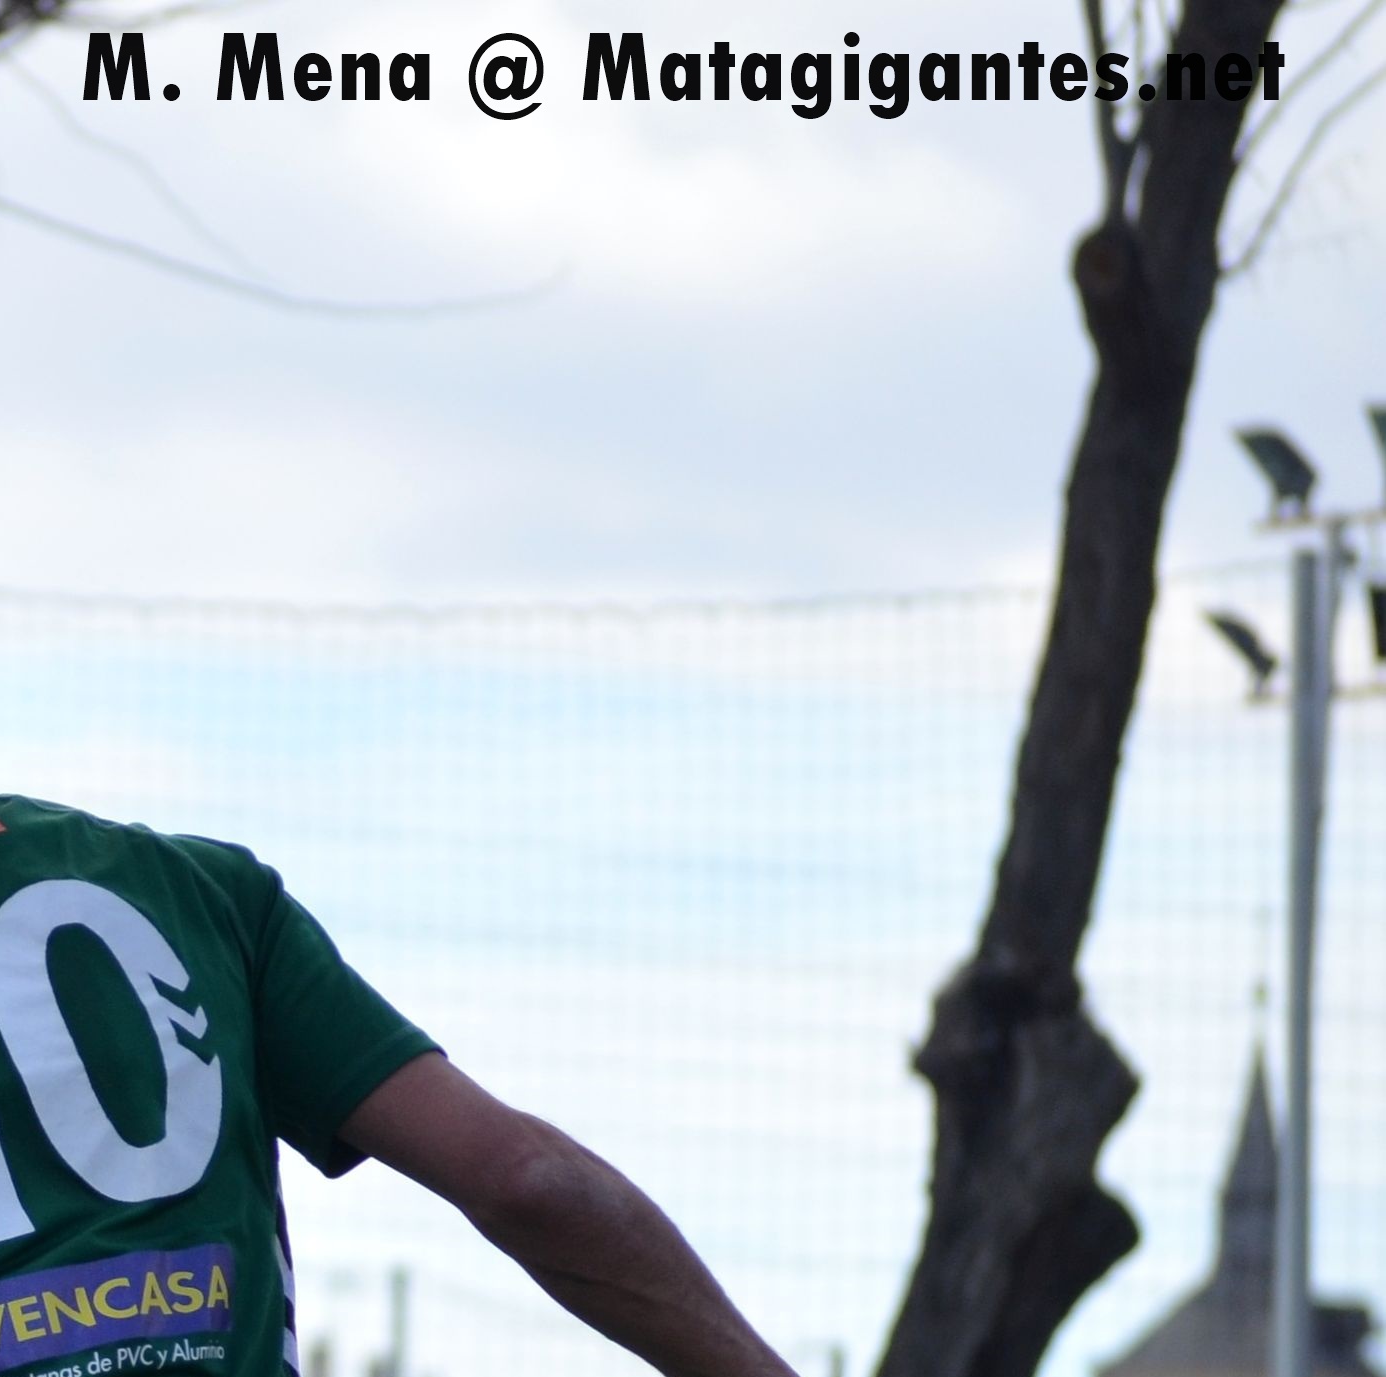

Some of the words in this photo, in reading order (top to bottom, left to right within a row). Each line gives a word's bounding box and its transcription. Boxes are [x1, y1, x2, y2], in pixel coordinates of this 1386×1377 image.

[87, 1351, 113, 1376] de
[117, 1344, 154, 1370] PVC
[157, 1350, 169, 1371] y
